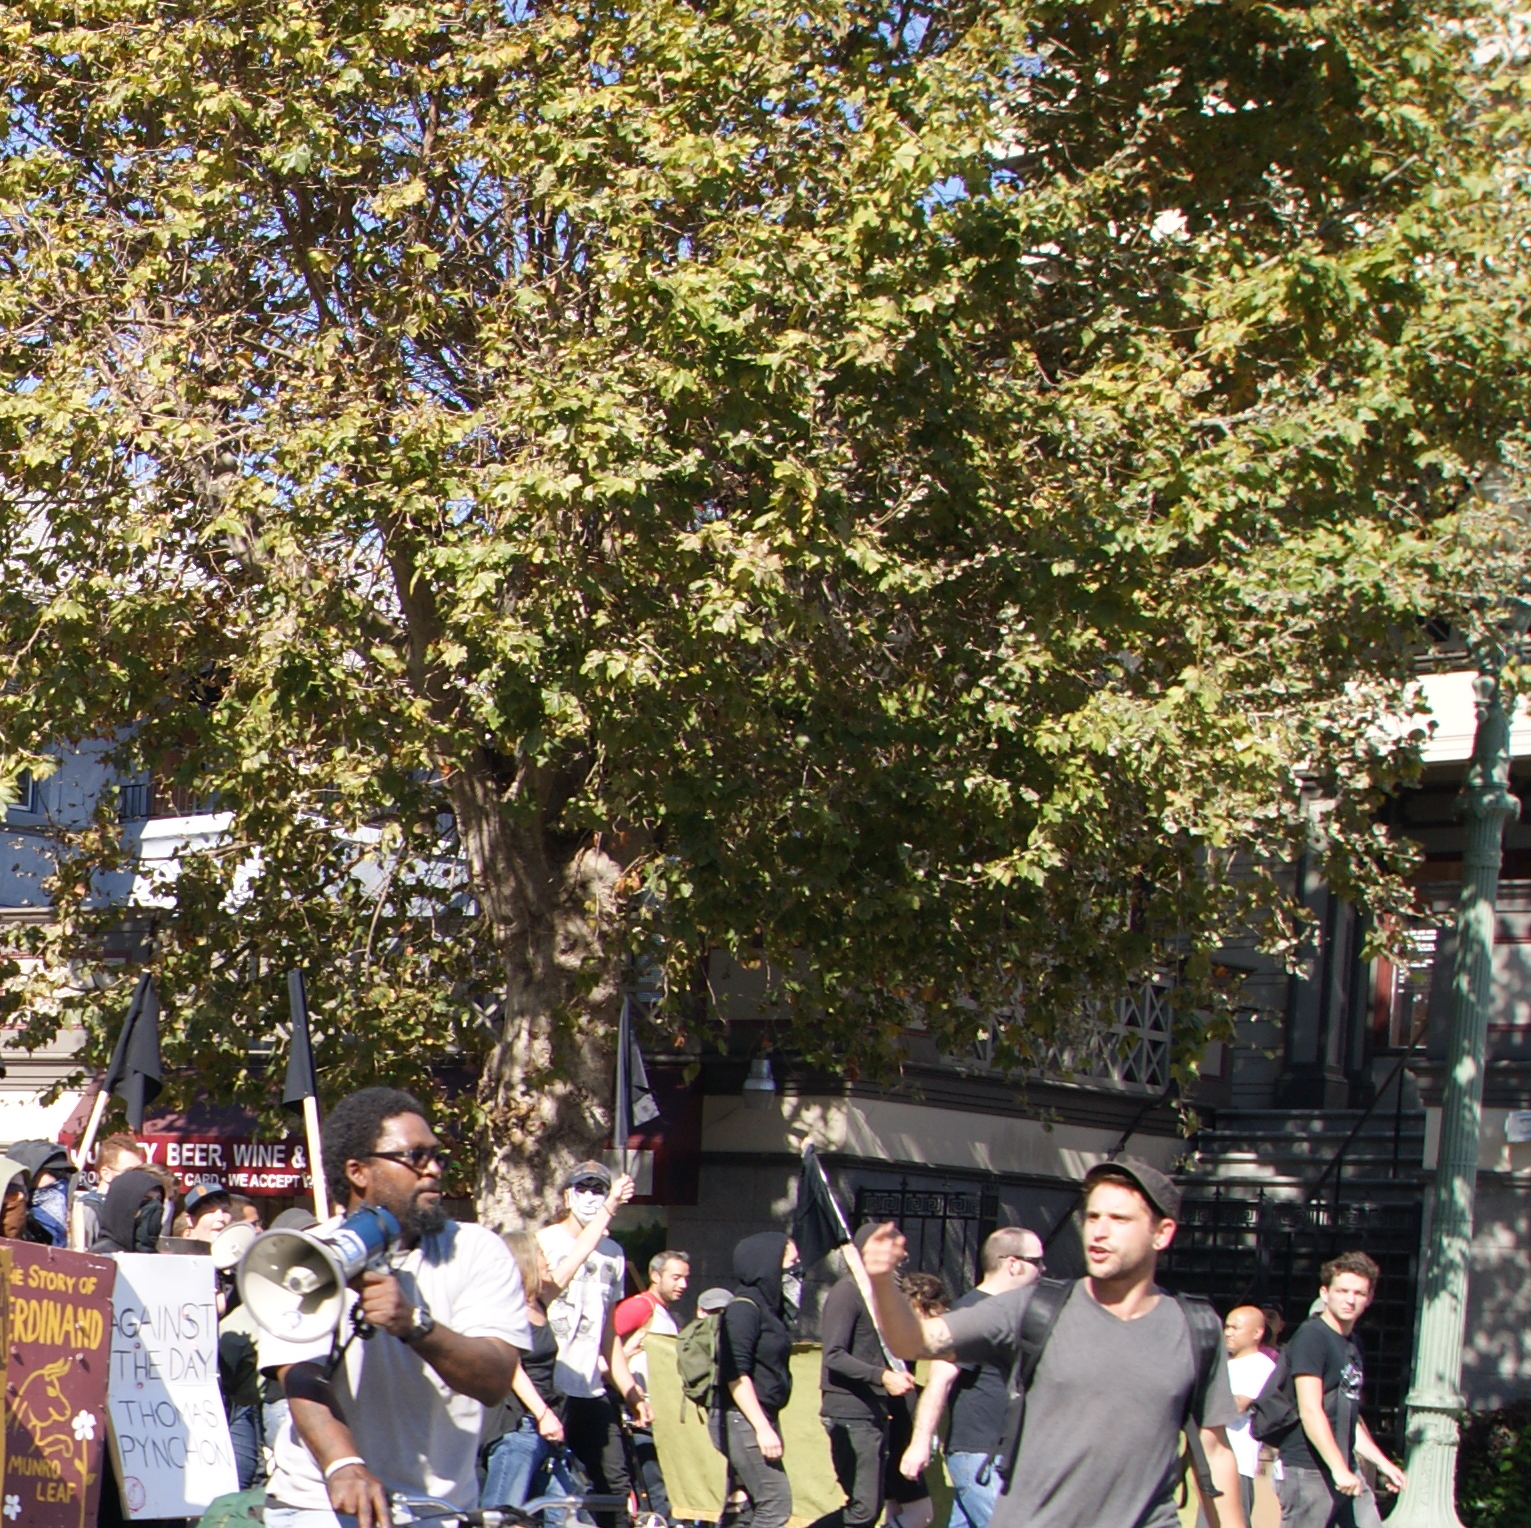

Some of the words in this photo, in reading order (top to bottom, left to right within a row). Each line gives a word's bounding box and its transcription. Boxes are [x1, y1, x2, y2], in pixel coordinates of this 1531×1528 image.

[167, 1143, 227, 1170] BEER,
[233, 1144, 285, 1168] WINE
[291, 1145, 307, 1168] &
[185, 1173, 219, 1187] CARD
[228, 1174, 249, 1188] WE
[250, 1174, 299, 1189] ACCEPT
[28, 1264, 77, 1294] STORY
[79, 1277, 97, 1294] OF
[113, 1350, 162, 1380] THE
[170, 1348, 213, 1382] DAY
[118, 1399, 219, 1428] THOMAS
[8, 1455, 62, 1477] MUNRO
[119, 1435, 232, 1469] PYNCHON
[36, 1481, 77, 1503] LEAF
